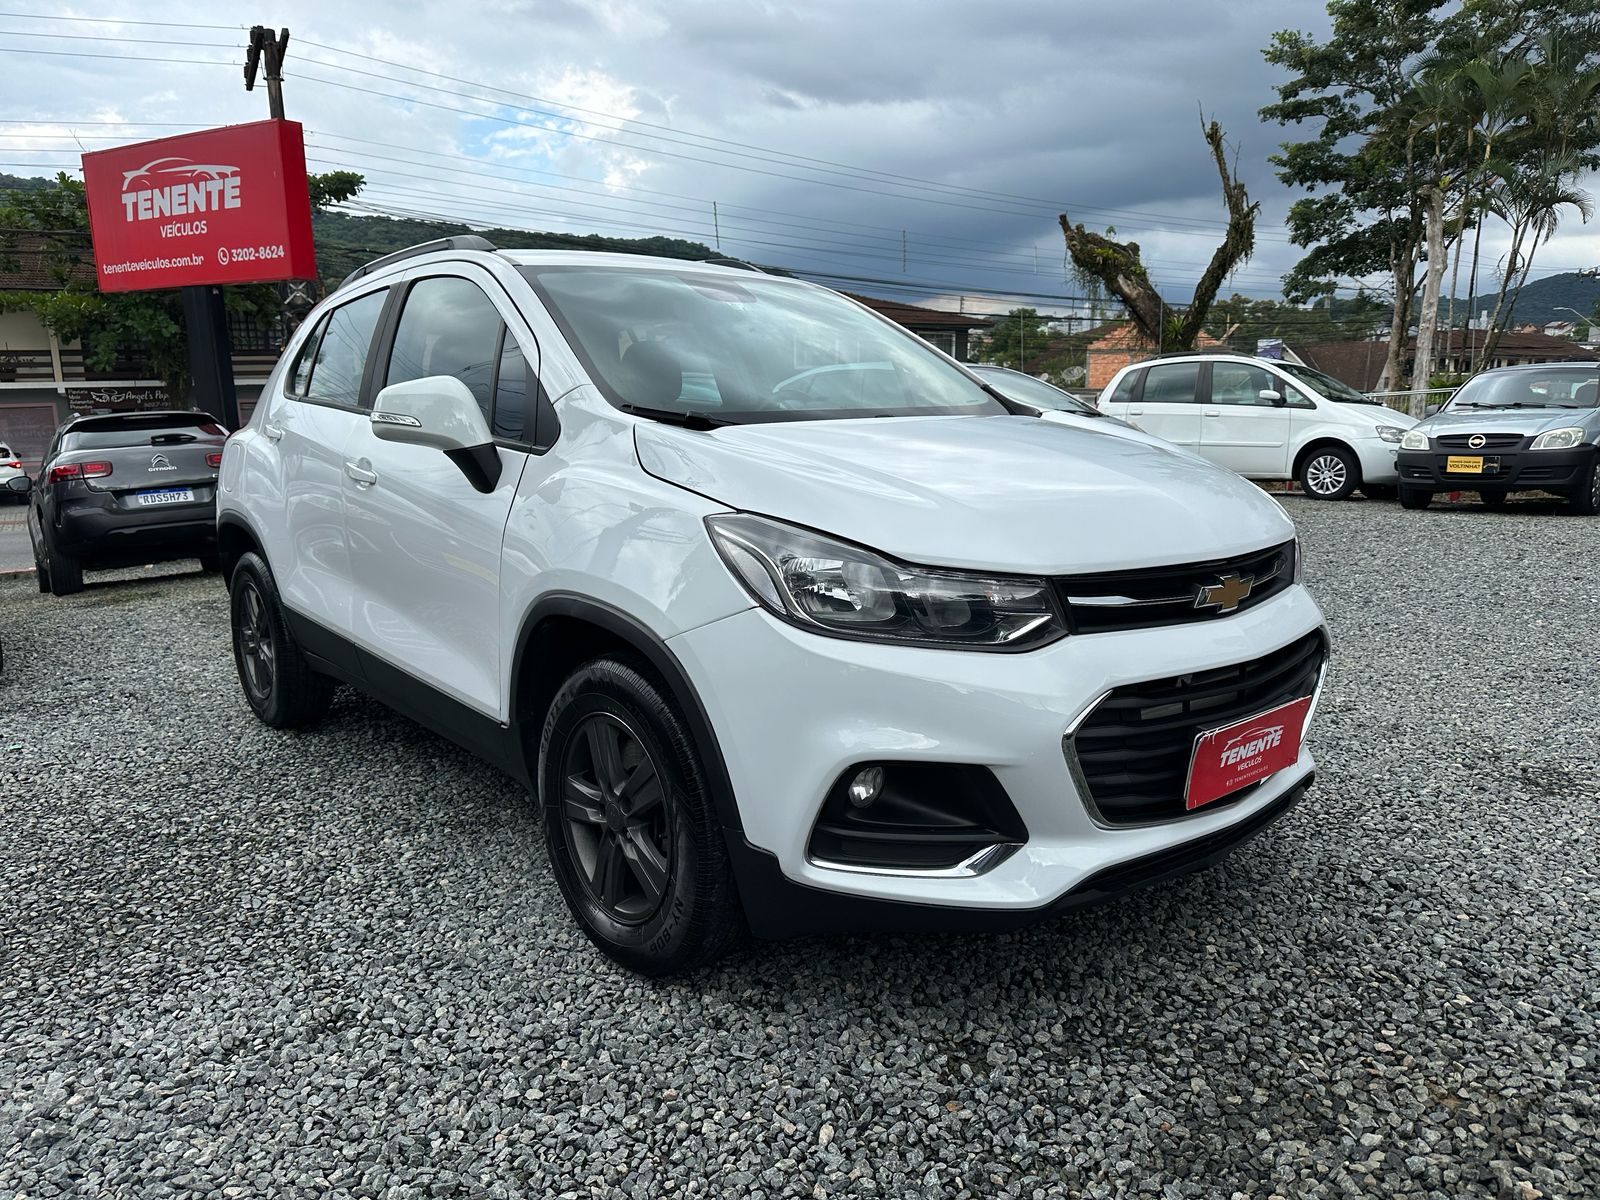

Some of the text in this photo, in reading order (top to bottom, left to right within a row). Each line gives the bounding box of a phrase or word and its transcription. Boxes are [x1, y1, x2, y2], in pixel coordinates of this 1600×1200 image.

[121, 176, 241, 222] TENENTE
[160, 220, 208, 239] VEÍCULOS
[231, 245, 285, 262] 3202-8624
[103, 253, 205, 275] tenenteveiculos.com.br
[125, 390, 153, 404] Angel's
[143, 492, 189, 504] RDS5H73
[1220, 730, 1284, 768] TENENTE
[649, 896, 684, 953] NY-806
